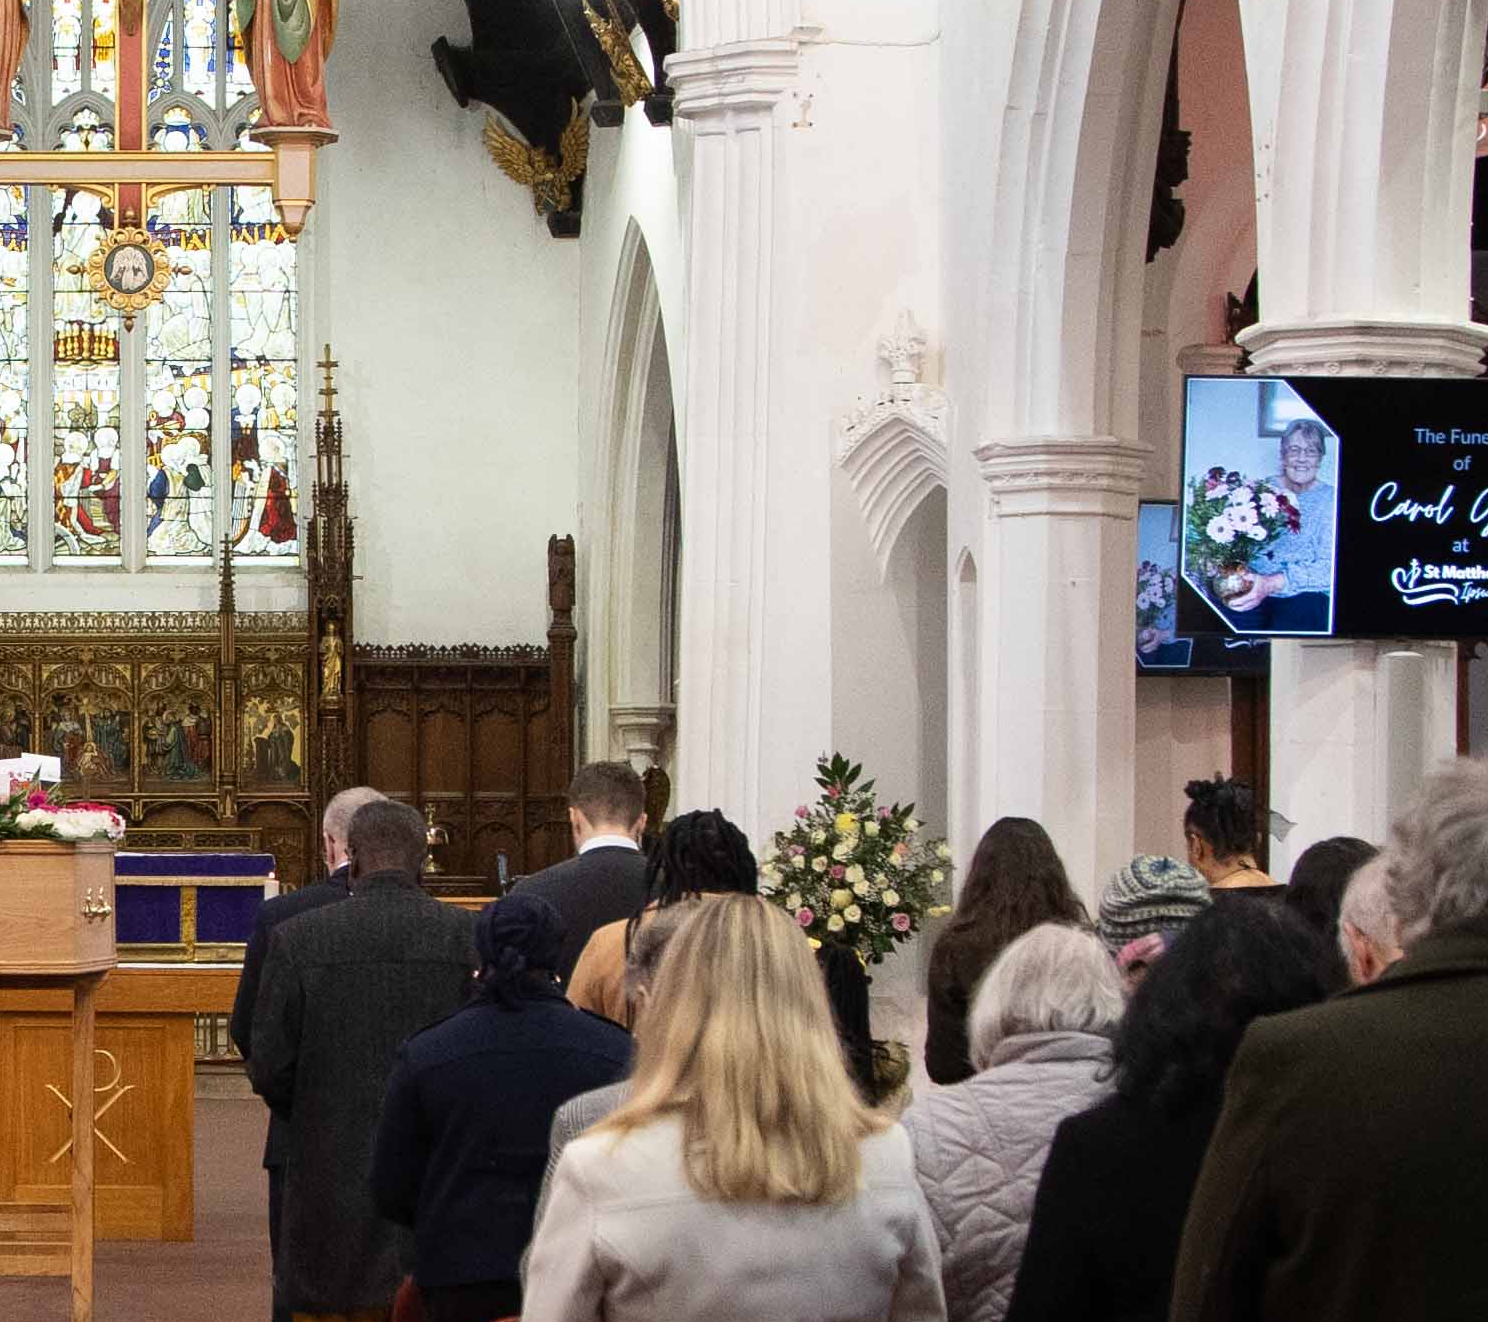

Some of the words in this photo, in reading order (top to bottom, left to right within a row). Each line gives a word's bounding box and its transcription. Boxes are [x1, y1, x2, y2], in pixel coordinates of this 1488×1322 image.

[1415, 429, 1446, 444] The
[1453, 455, 1472, 471] of
[1370, 481, 1454, 525] Carol
[1452, 538, 1470, 553] at
[1423, 564, 1441, 579] St
